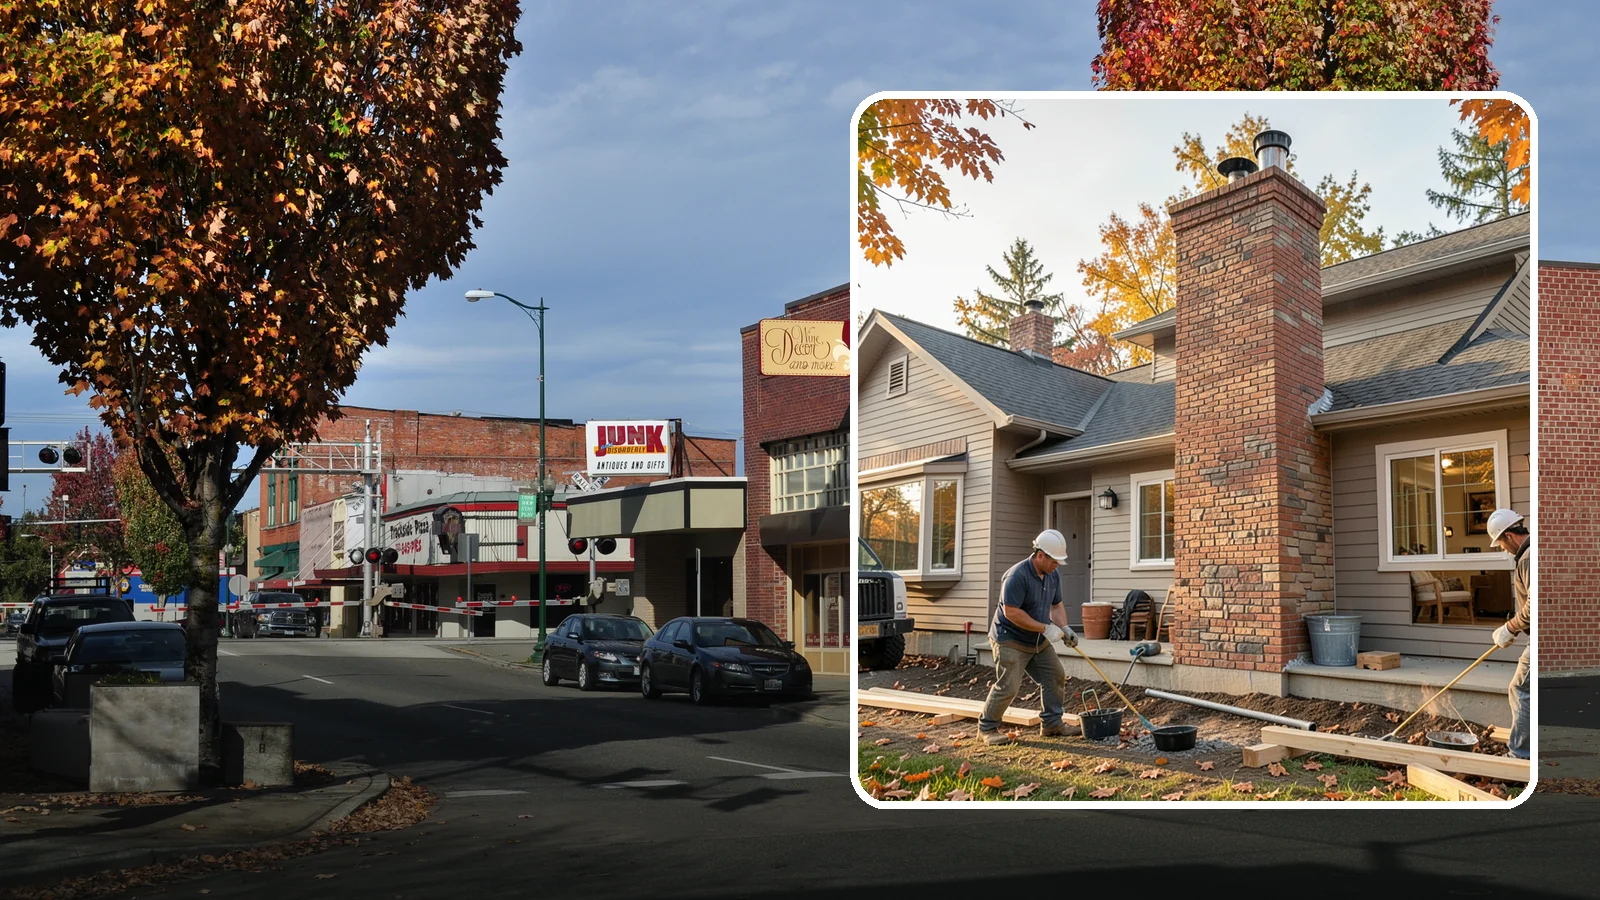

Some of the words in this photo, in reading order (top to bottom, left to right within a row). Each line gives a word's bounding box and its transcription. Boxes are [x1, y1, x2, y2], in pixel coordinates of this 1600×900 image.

[595, 425, 665, 457] JUNK
[607, 446, 647, 454] DISORDERLY
[596, 461, 628, 470] ANTIQUES
[631, 461, 644, 470] AND
[646, 460, 666, 470] GIFTS
[390, 522, 413, 540] Trackside
[414, 519, 429, 535] Pizza
